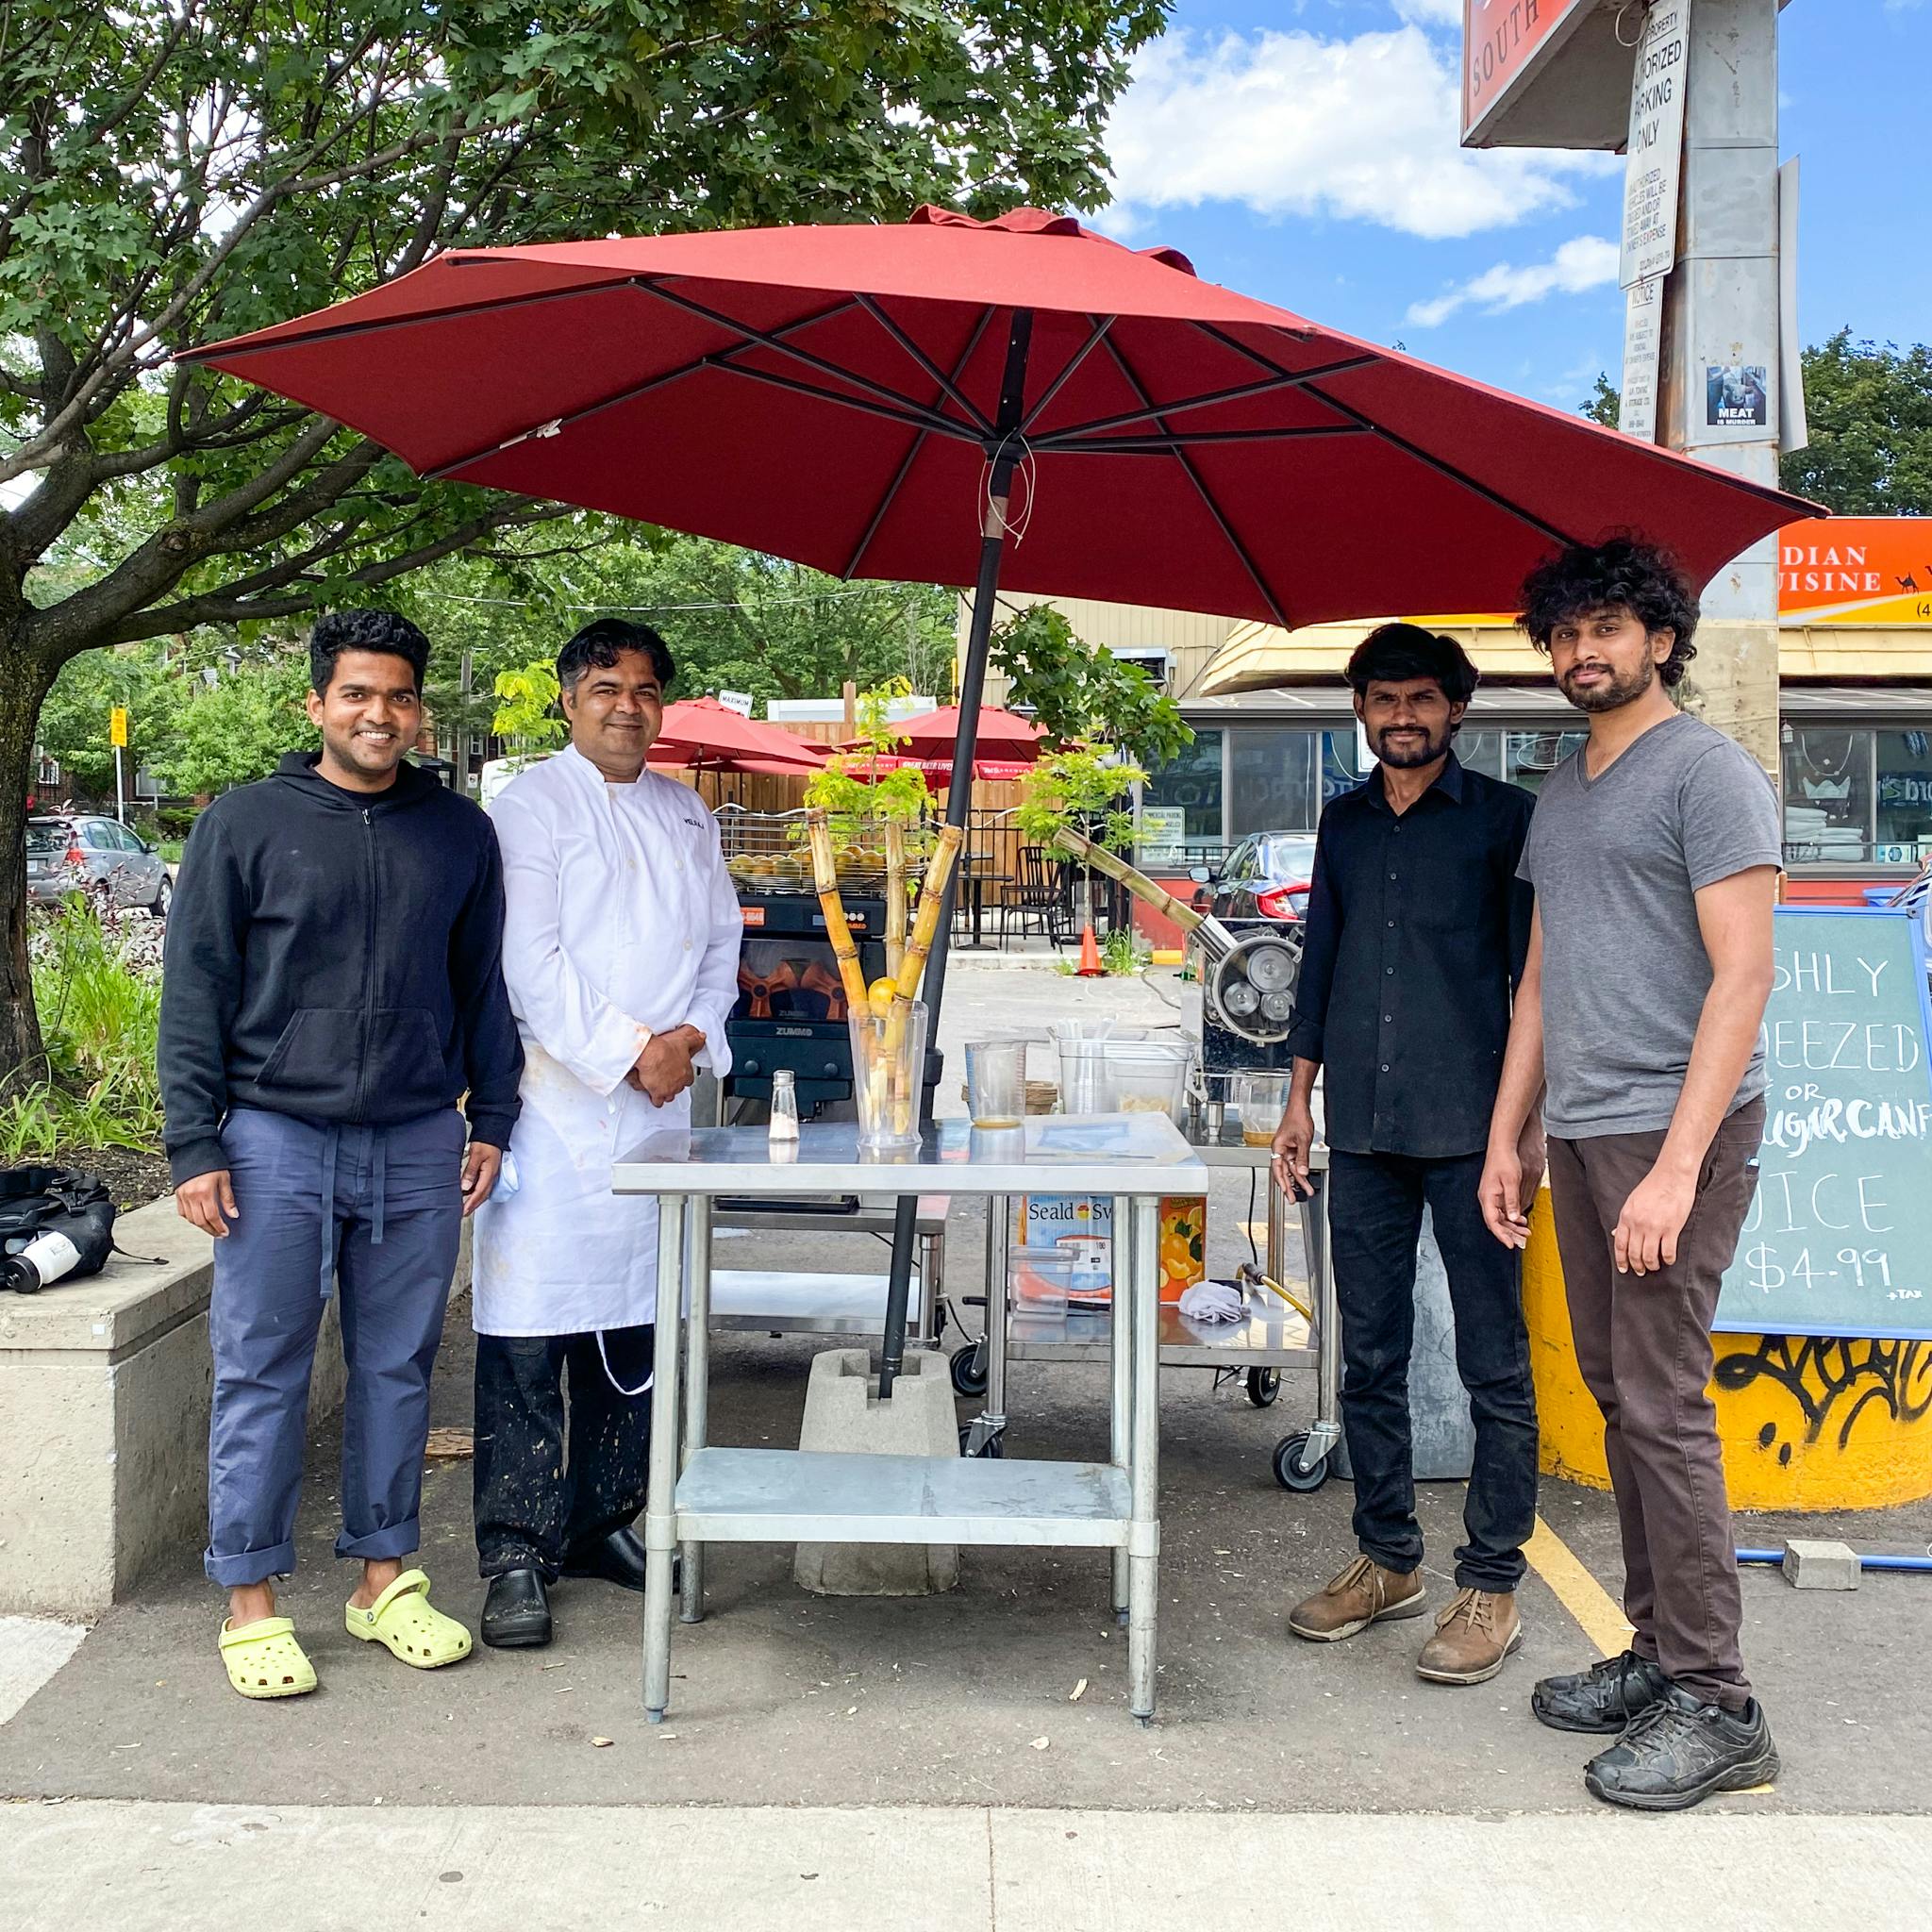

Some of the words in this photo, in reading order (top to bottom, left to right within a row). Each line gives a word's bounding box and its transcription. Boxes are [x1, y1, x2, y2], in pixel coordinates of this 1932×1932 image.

[1473, 0, 1539, 97] SOUTH
[1637, 118, 1659, 154] ONLY
[1632, 283, 1654, 306] NOTICE
[1718, 408, 1755, 418] MEAT
[1783, 546, 1867, 566] DIAN
[722, 695, 750, 707] MAXIMUM
[776, 1026, 813, 1037] ZUMMO
[1785, 1083, 1826, 1102] OR
[1028, 1202, 1074, 1221] Seald
